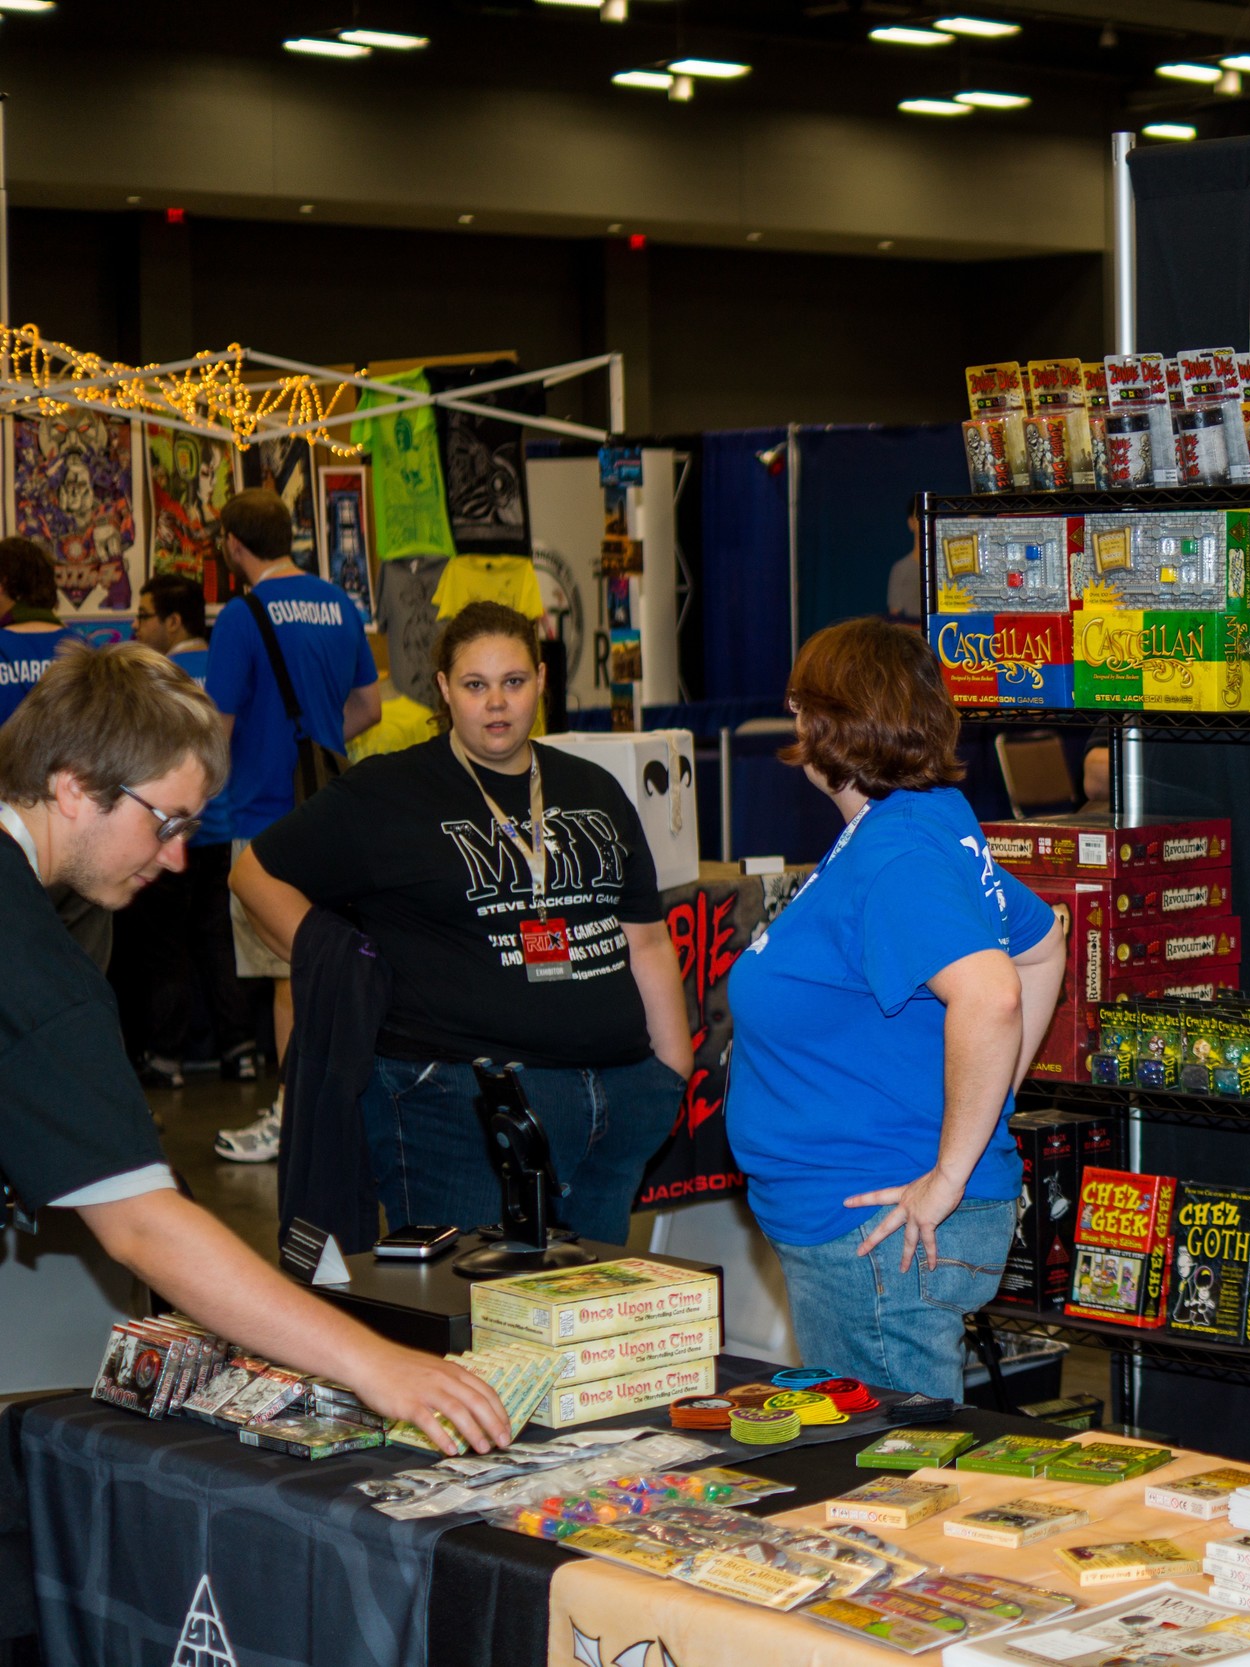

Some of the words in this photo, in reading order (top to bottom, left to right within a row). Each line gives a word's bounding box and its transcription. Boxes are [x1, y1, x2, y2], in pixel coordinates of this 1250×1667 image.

[1109, 362, 1139, 383] ZOMBIE
[1142, 361, 1166, 382] DICE
[267, 600, 343, 626] GUARDIAN
[938, 621, 1053, 672] CASTELLAN
[1082, 617, 1204, 672] CASTELLAN
[953, 693, 978, 703] STEVE
[979, 693, 1016, 704] JACKSON
[1017, 694, 1044, 704] GAMES
[1164, 839, 1208, 858] REVOLUTION!
[477, 900, 526, 917] STEVE
[529, 894, 592, 909] JACKSON
[596, 893, 620, 905] GAME
[524, 931, 565, 953] RTX
[1166, 939, 1216, 958] REVOLUTION!
[501, 950, 524, 967] AND
[571, 960, 626, 980] sjgames.com
[1089, 930, 1098, 1001] REVOLUTION!
[536, 967, 564, 977] EXHIBITOR
[1165, 1014, 1180, 1026] DICE
[1031, 1062, 1062, 1073] GAMES
[1043, 1145, 1071, 1156] BURGER
[1047, 1133, 1067, 1145] NINJA
[641, 1172, 744, 1205] JACKSON
[1082, 1181, 1141, 1212] CHEZ
[1091, 1207, 1150, 1238] GEEK
[1155, 1185, 1173, 1239] GEEK
[1179, 1201, 1241, 1226] CHEZ
[1100, 1235, 1118, 1247] Party
[1119, 1238, 1143, 1250] Edition
[1187, 1226, 1250, 1263] GOTH
[1147, 1244, 1165, 1299] CHEZ
[579, 1307, 614, 1324] Once
[617, 1299, 653, 1318] Upon
[656, 1299, 665, 1312] a
[667, 1291, 703, 1309] Time
[645, 1310, 672, 1321] Storytelling
[672, 1308, 684, 1316] Card
[686, 1306, 700, 1314] Game
[581, 1348, 616, 1365] Once
[619, 1340, 655, 1359] Upon
[657, 1339, 666, 1352] a
[669, 1331, 704, 1349] Time
[95, 1374, 139, 1404] Gloom
[153, 1371, 175, 1412] Gloom
[579, 1390, 613, 1407] Once
[617, 1382, 652, 1401] Upon
[655, 1379, 663, 1392] a
[666, 1371, 700, 1389] Time
